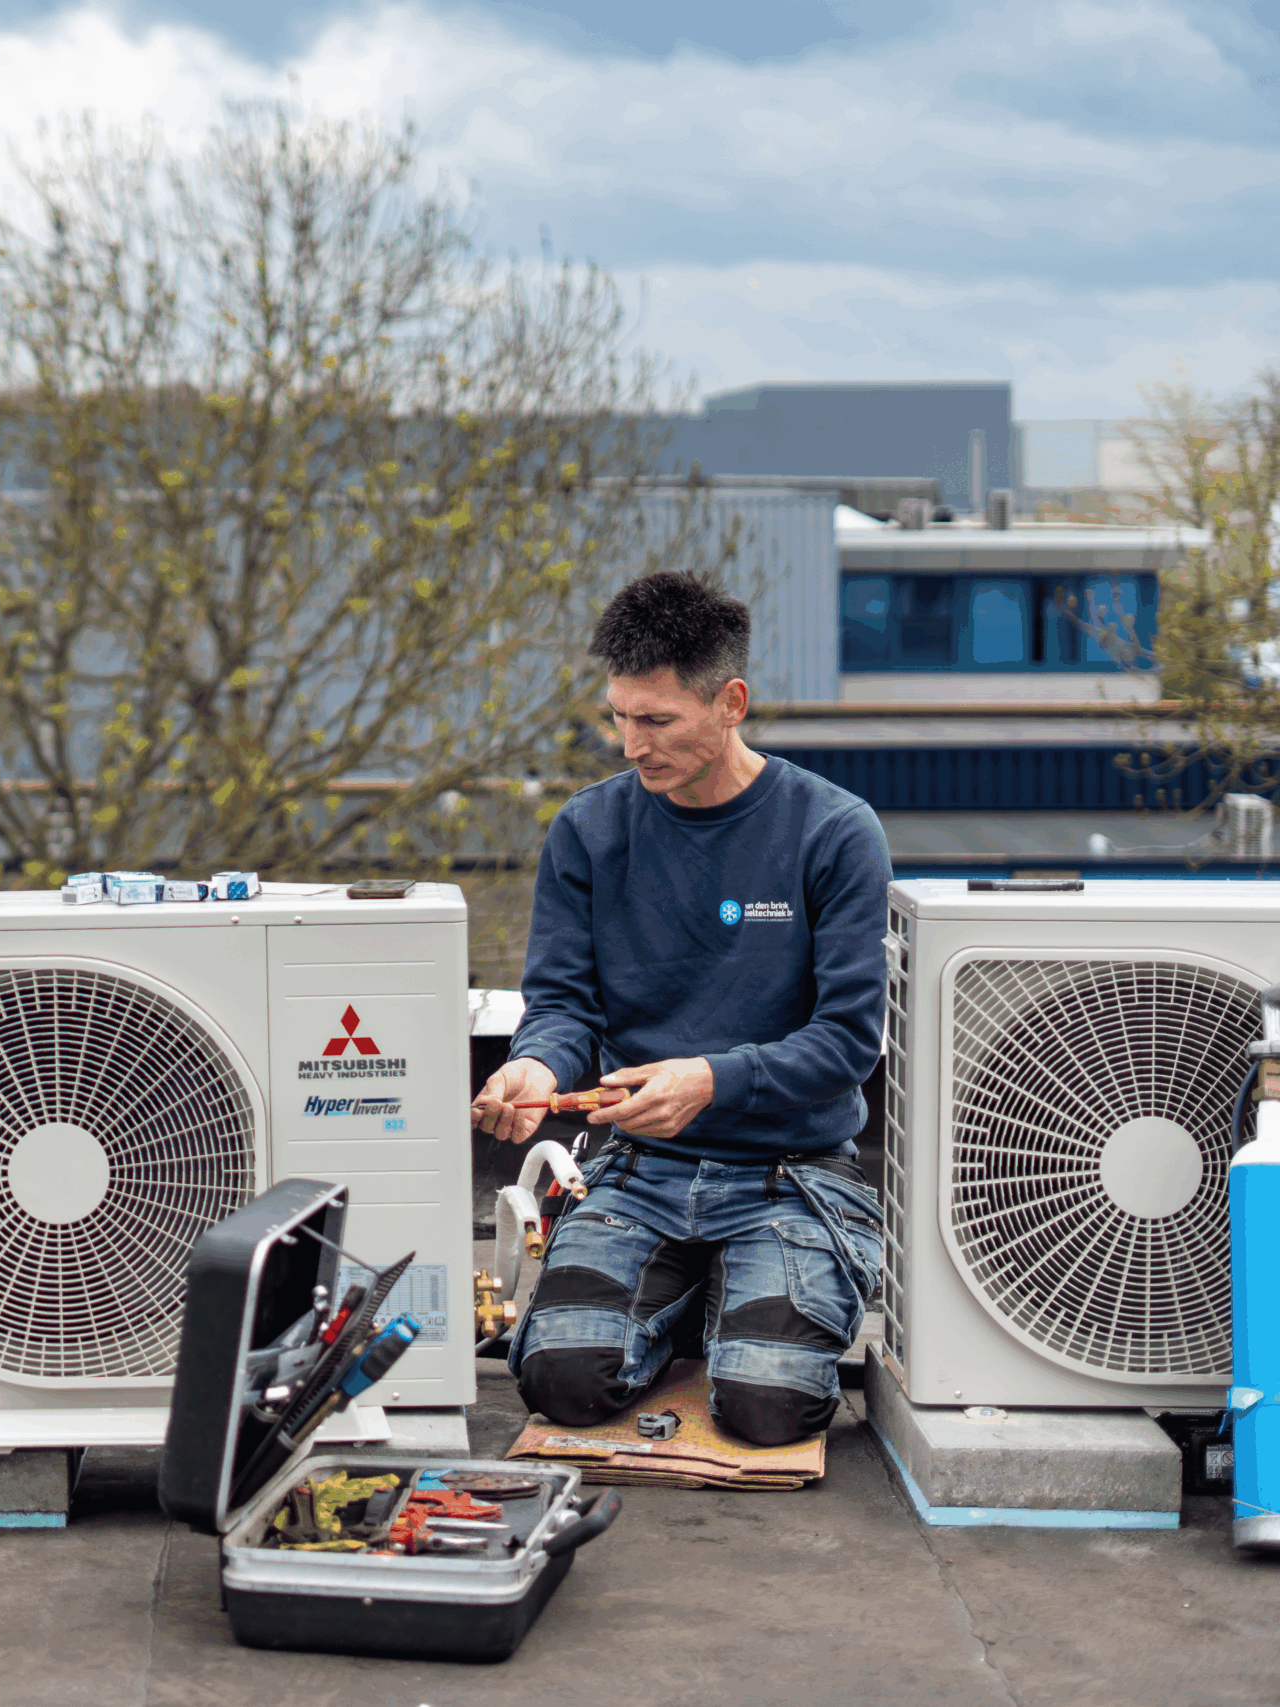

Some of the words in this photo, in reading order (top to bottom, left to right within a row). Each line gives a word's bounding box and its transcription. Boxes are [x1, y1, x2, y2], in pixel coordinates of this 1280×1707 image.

[755, 901, 770, 909] den
[771, 901, 789, 909] brink
[298, 1058, 407, 1072] MITSUBISHI
[298, 1071, 334, 1079] HEAVY
[337, 1069, 407, 1079] INDUSTRIES
[303, 1095, 355, 1116] Hyper
[352, 1098, 402, 1115] Inverter
